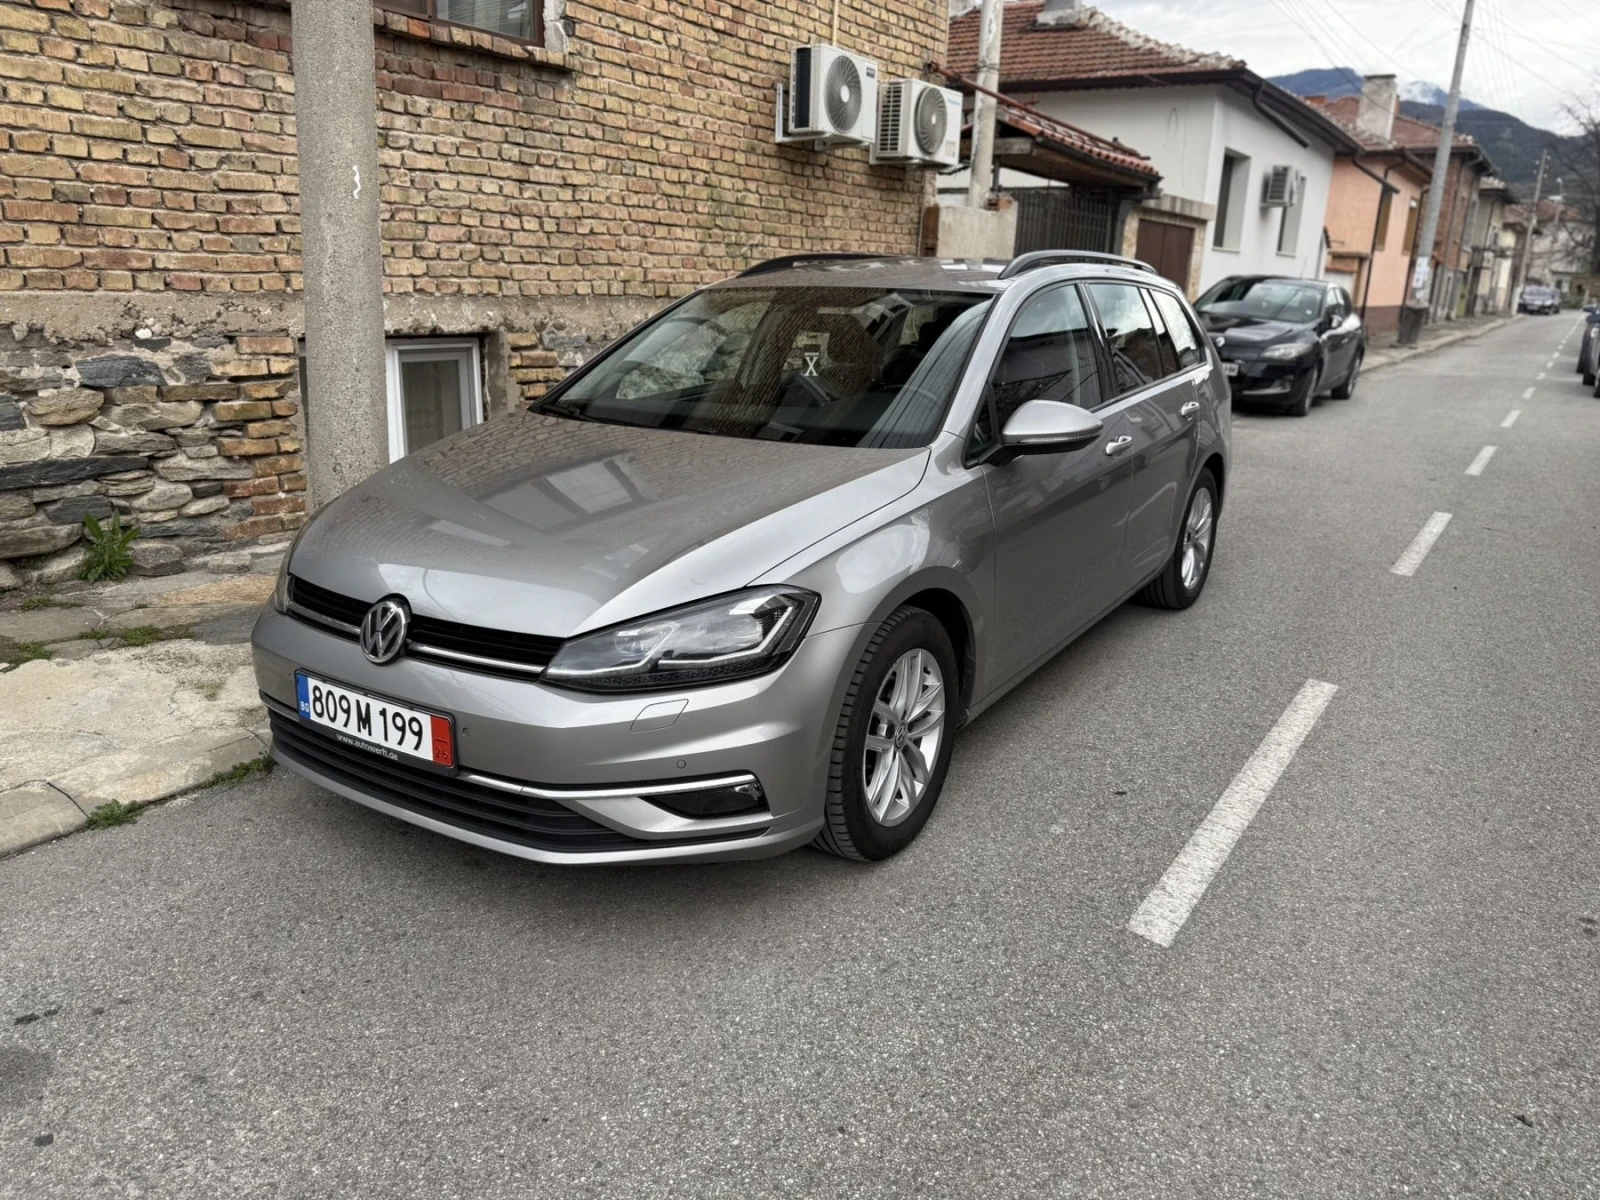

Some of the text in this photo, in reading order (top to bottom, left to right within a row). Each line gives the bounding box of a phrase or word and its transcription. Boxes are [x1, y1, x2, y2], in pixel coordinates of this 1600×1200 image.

[362, 601, 405, 663] VW
[300, 700, 310, 713] BG
[312, 685, 423, 751] 809 M 199
[436, 746, 448, 760] 26
